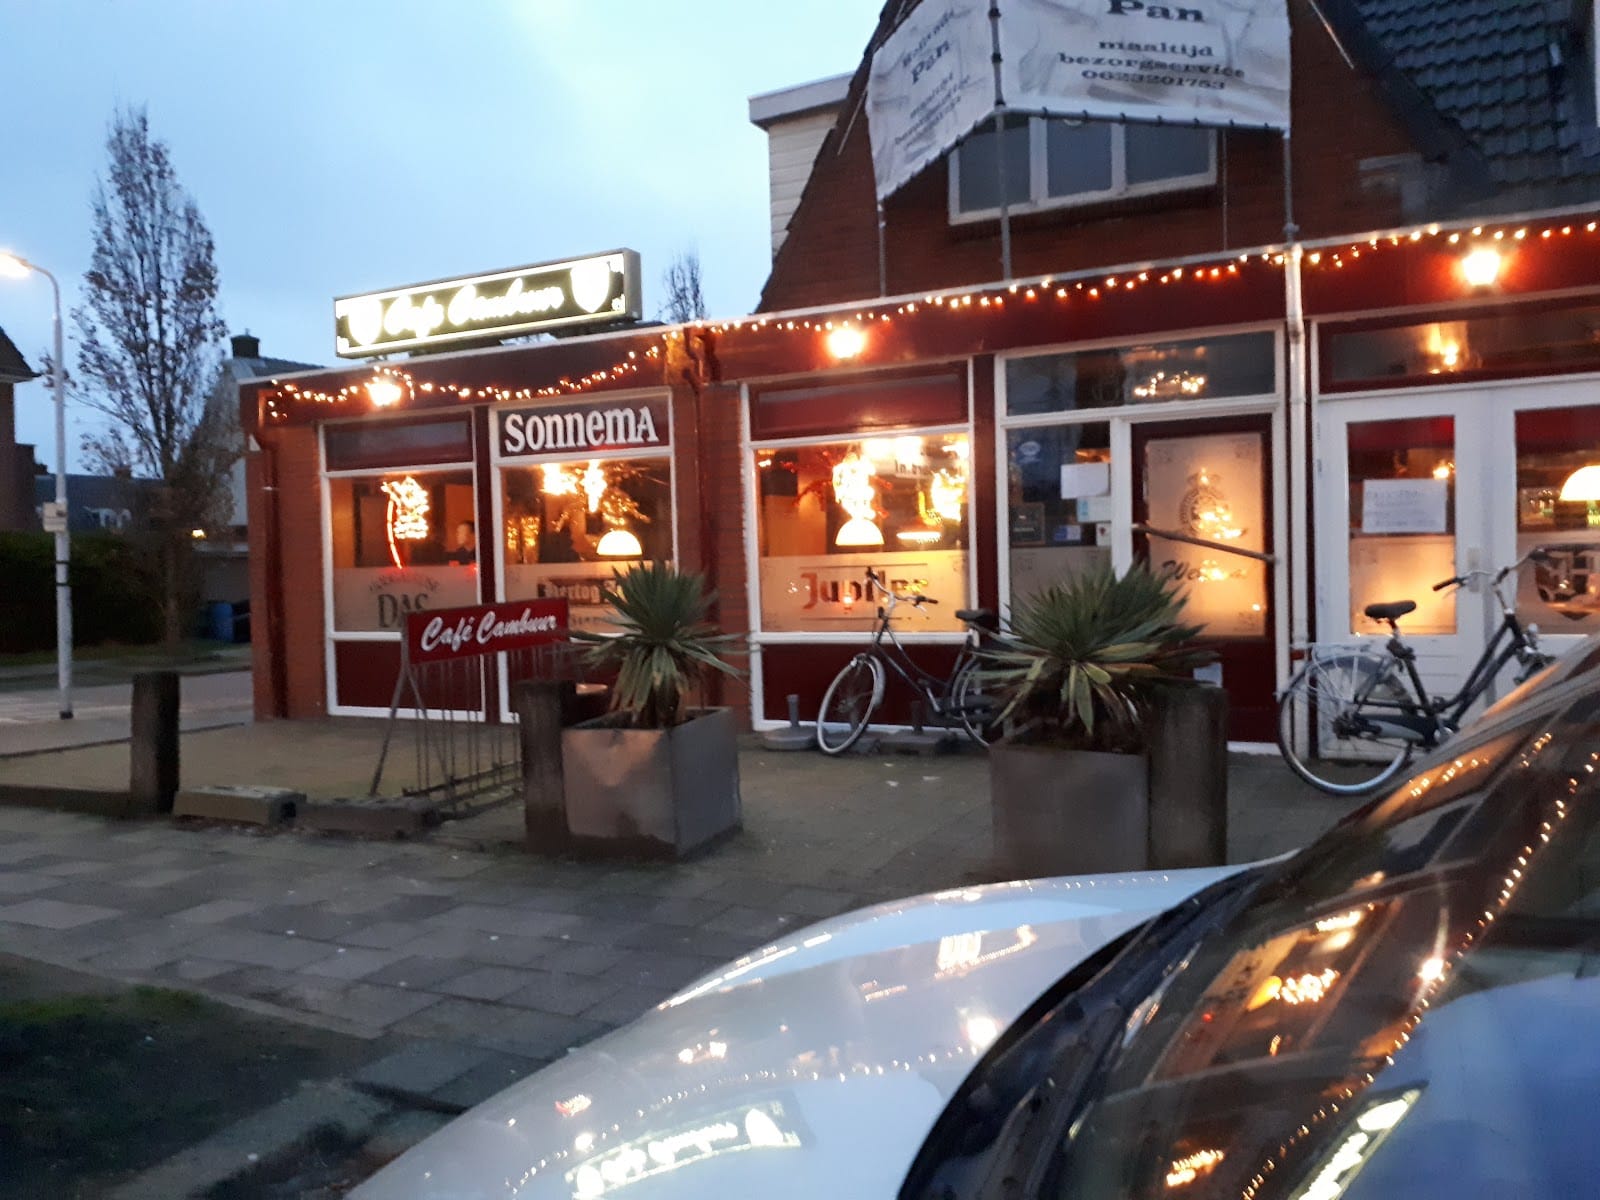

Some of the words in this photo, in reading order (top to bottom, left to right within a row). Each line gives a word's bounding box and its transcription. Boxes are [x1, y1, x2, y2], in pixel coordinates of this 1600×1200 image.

[1107, 0, 1205, 23] Pan
[1098, 40, 1214, 58] maaltijd
[911, 41, 950, 84] Pan
[1057, 52, 1246, 78] bezorgservice
[421, 616, 475, 652] Café
[476, 608, 557, 644] Cambuur
